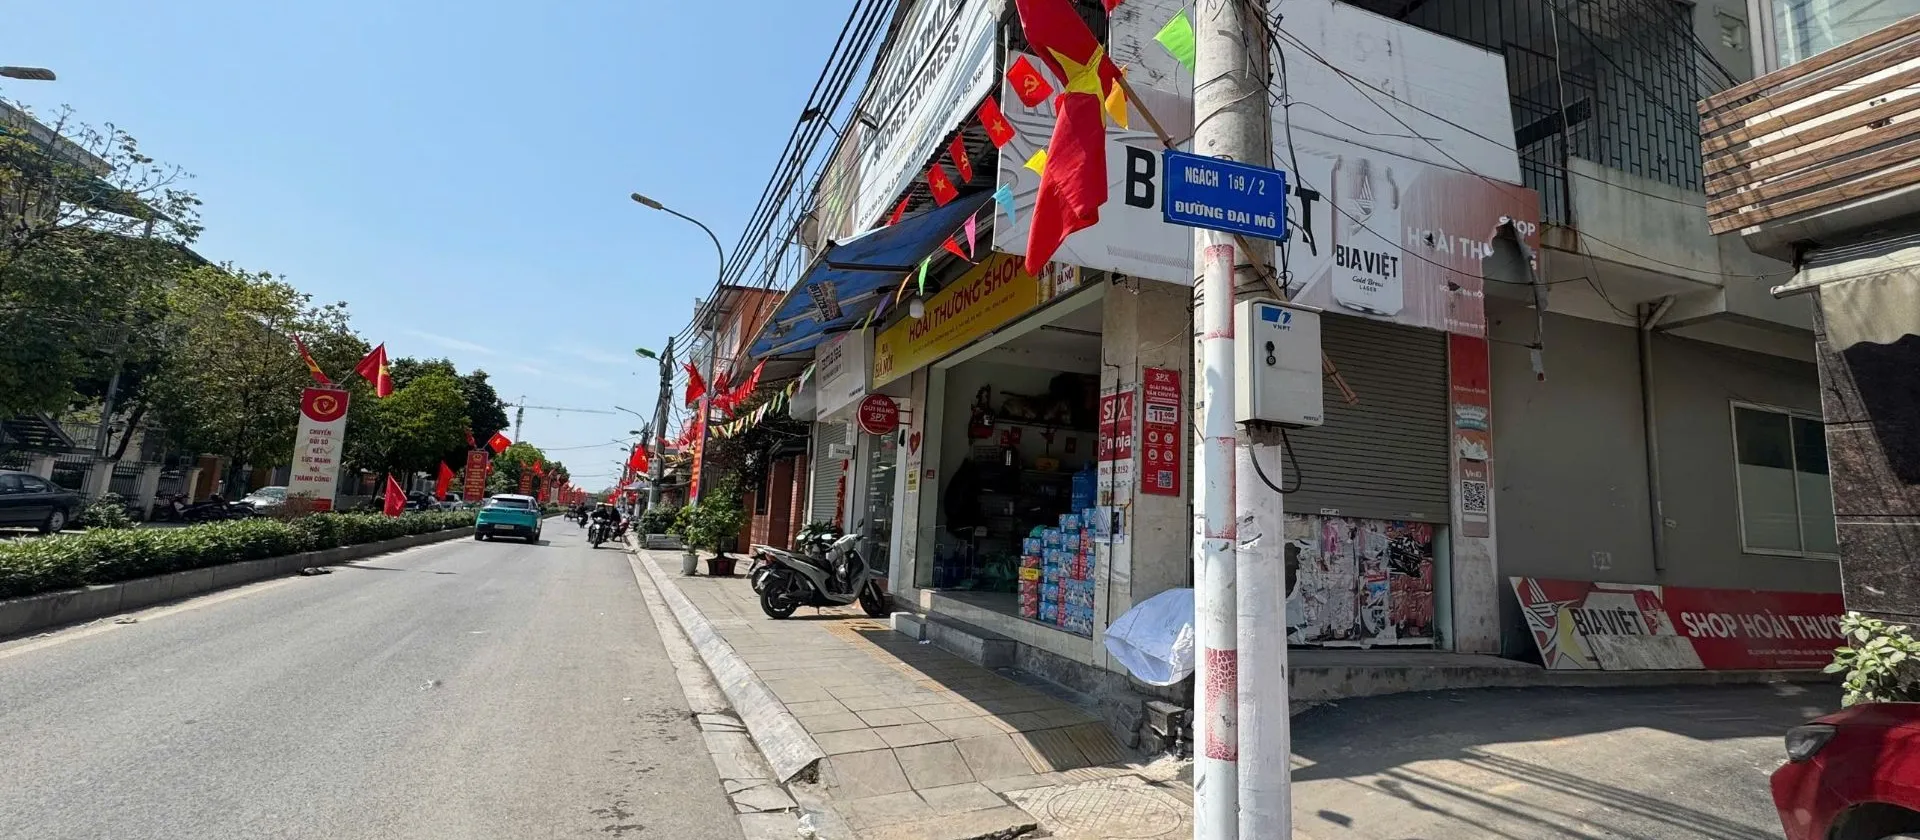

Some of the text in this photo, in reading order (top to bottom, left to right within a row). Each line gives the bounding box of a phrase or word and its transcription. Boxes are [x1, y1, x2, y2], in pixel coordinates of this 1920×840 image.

[972, 67, 984, 86] Nội
[873, 101, 907, 166] SHOPEE
[908, 24, 960, 116] EXPRESS
[1185, 165, 1219, 188] NGÁCH
[1258, 179, 1265, 196] 2
[1175, 199, 1276, 229] ĐƯỜNG ĐẠI MỖ
[1352, 275, 1384, 288] Cold Brew
[909, 309, 932, 345] HOÀI
[933, 280, 981, 328] THƯƠNG
[984, 255, 1026, 297] SHOP
[1273, 323, 1291, 331] VNPT
[1156, 373, 1170, 382] SPX
[870, 411, 887, 421] SPX
[1107, 430, 1131, 452] nnja
[1681, 611, 1739, 639] SHOP
[1738, 608, 1794, 639] HOÀI
